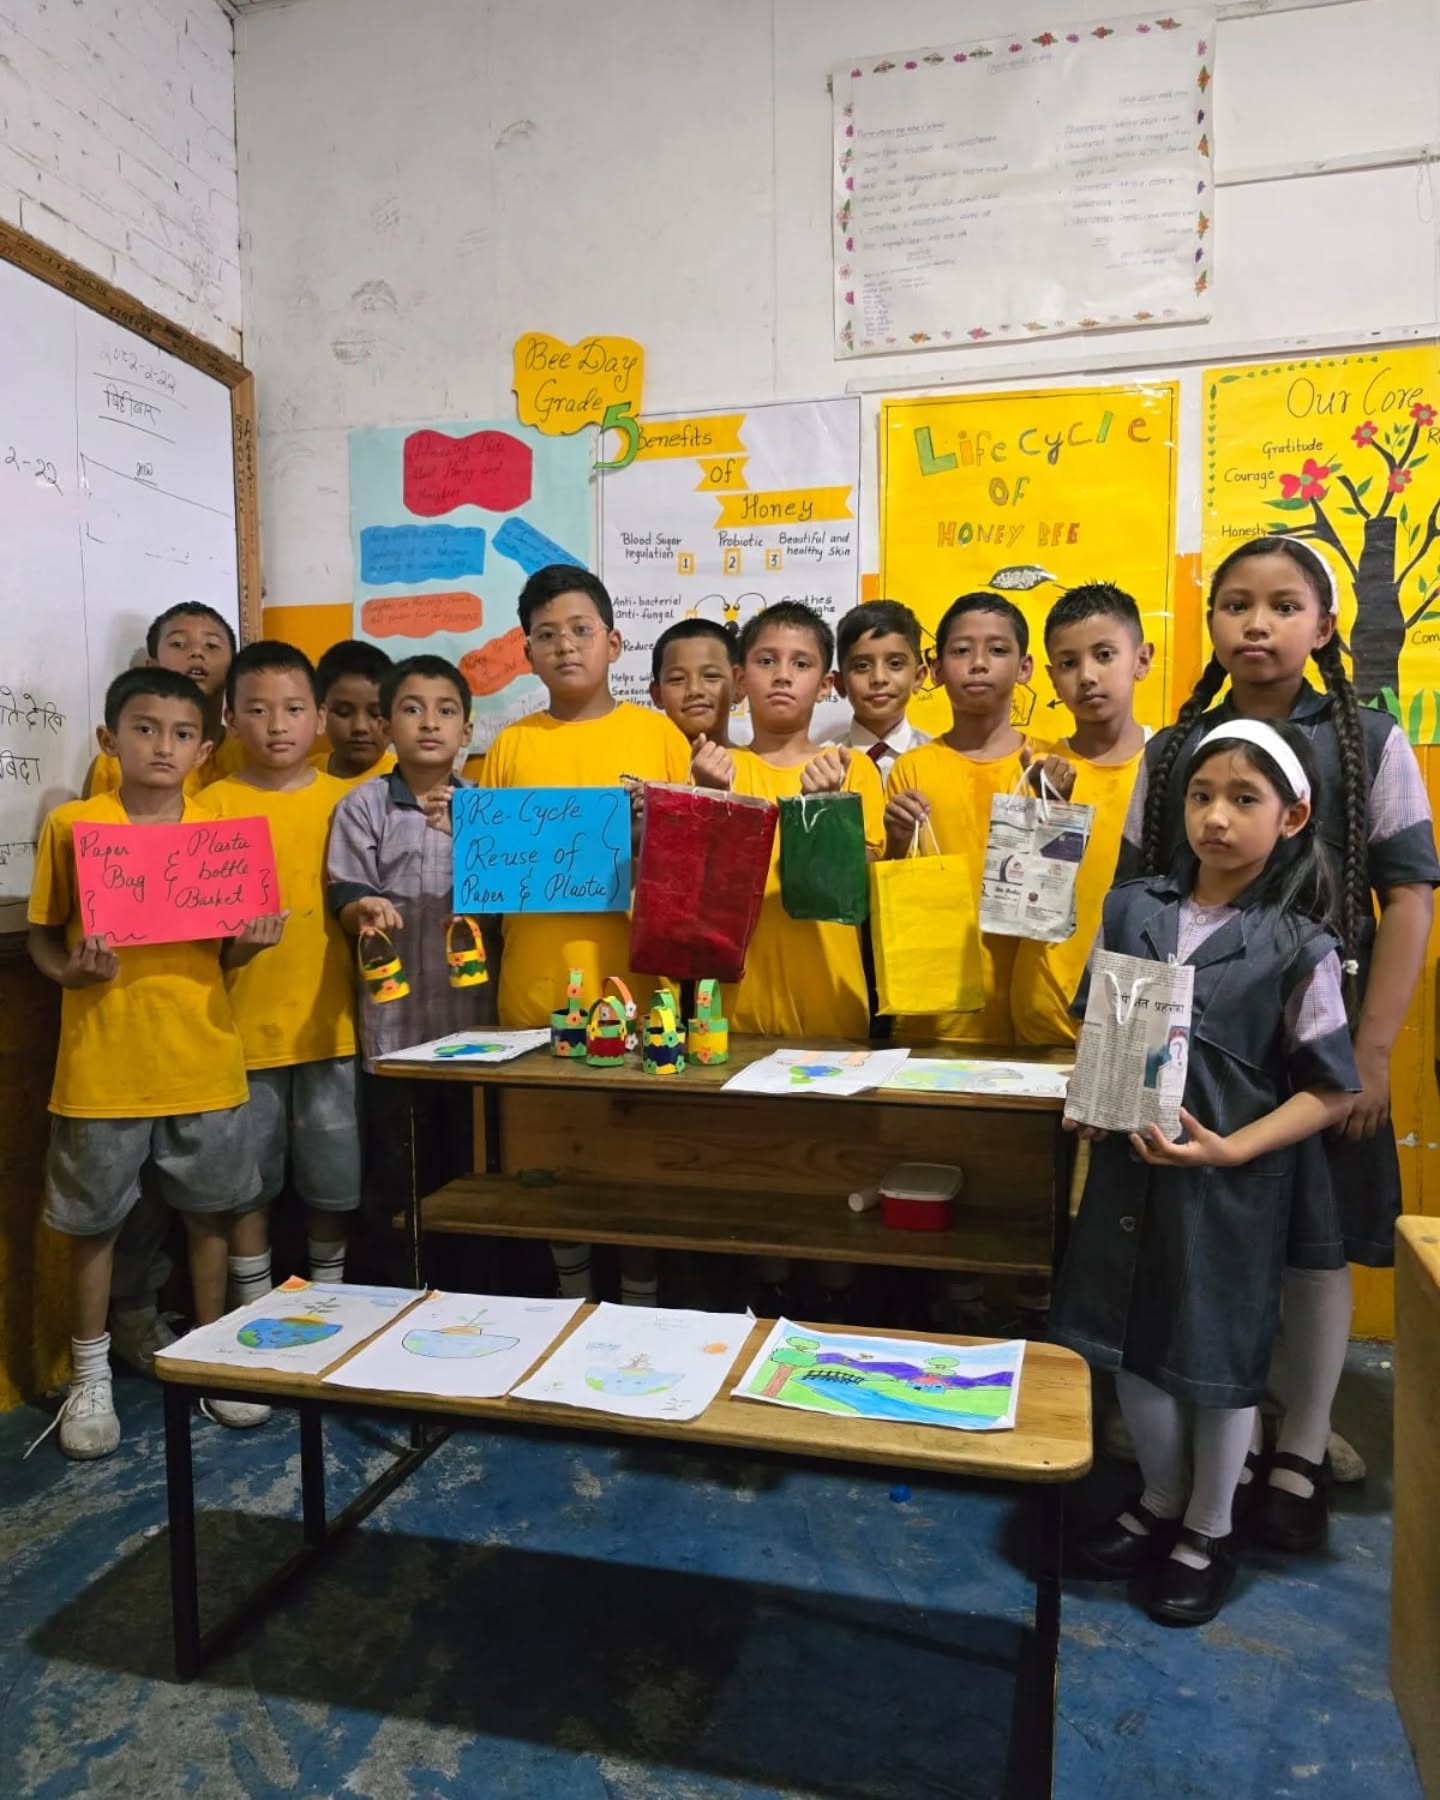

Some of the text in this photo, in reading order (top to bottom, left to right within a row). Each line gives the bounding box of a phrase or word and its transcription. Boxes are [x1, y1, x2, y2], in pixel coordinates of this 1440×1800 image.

[525, 337, 639, 393] Bee Day
[1287, 367, 1424, 419] Our Core
[534, 378, 640, 470] Grade 5
[638, 424, 712, 450] Benefits
[1262, 438, 1323, 459] Gratitude
[1224, 467, 1276, 489] Courage
[741, 495, 814, 522] Honey
[621, 532, 683, 550] Blood Sugar
[718, 530, 763, 547] Probiotic
[778, 531, 850, 545] Beautiful and
[937, 521, 1081, 548] HONEY BEE
[1222, 524, 1267, 538] Honesty
[625, 548, 674, 564] regulation
[682, 557, 689, 569] 1
[728, 556, 736, 569] 2
[770, 554, 778, 567] 3
[786, 545, 823, 562] healthy
[613, 594, 681, 607] Anti-bacterial
[615, 608, 674, 624] anti-fungal
[611, 672, 634, 686] Helps
[611, 686, 650, 696] Seasona
[80, 830, 130, 871] Paper
[465, 832, 586, 873] Reuse of
[199, 861, 249, 881] bottle
[102, 865, 146, 903] Bag
[460, 873, 505, 912] Paper
[544, 872, 607, 903] Plastic
[174, 884, 243, 909] Basket
